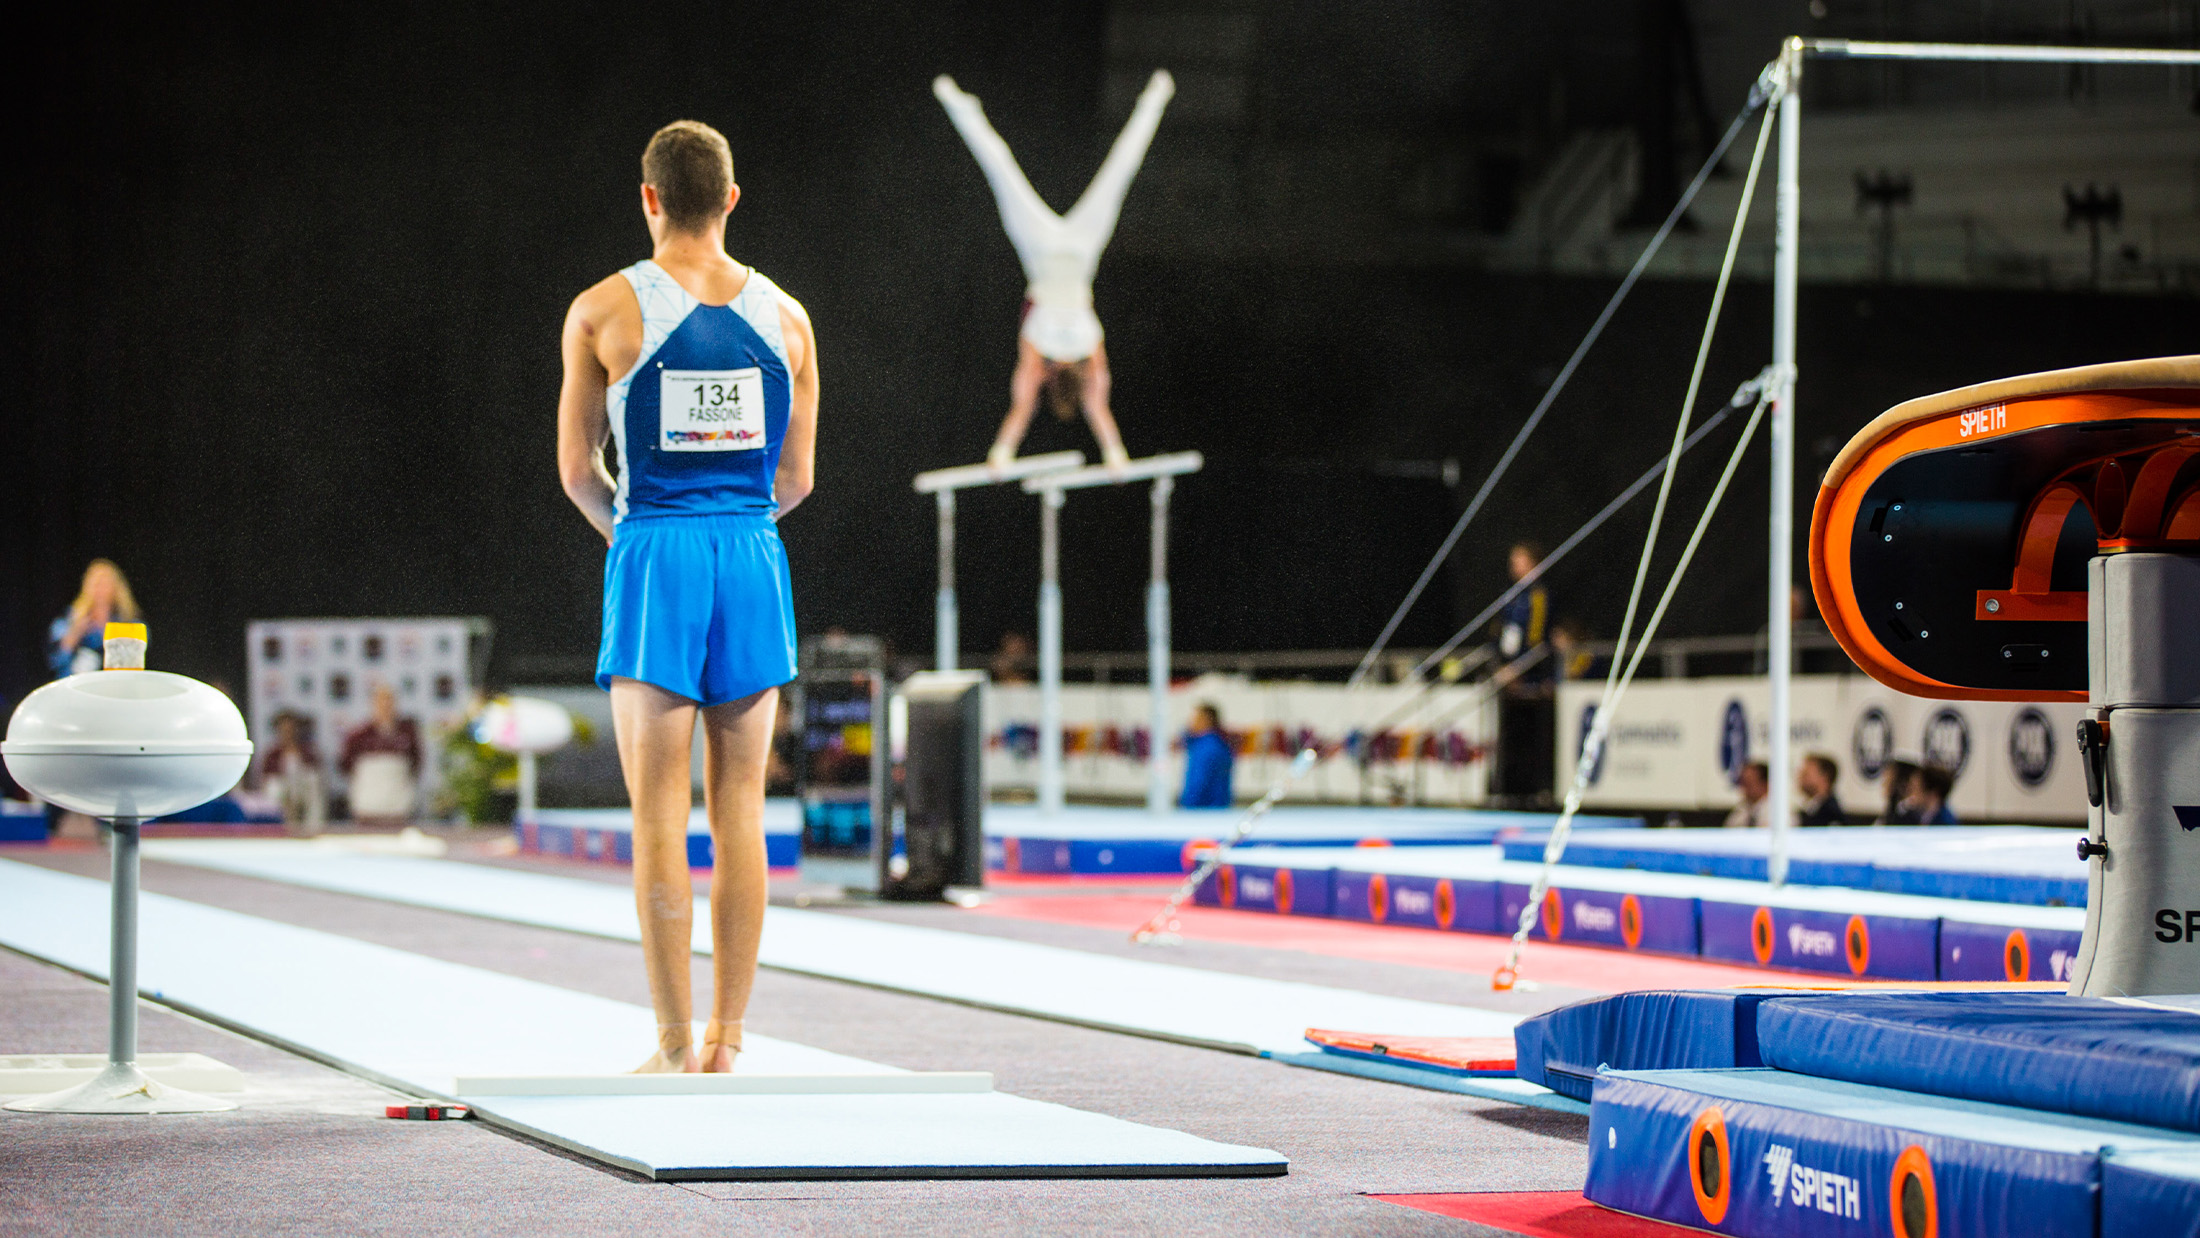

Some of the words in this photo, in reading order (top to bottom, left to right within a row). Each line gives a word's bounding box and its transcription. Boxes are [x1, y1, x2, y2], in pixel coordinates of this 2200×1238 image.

[694, 384, 739, 405] 134
[689, 407, 742, 422] FASSONE
[1960, 402, 2006, 437] SPIETH
[1791, 1163, 1860, 1220] SPIETH
